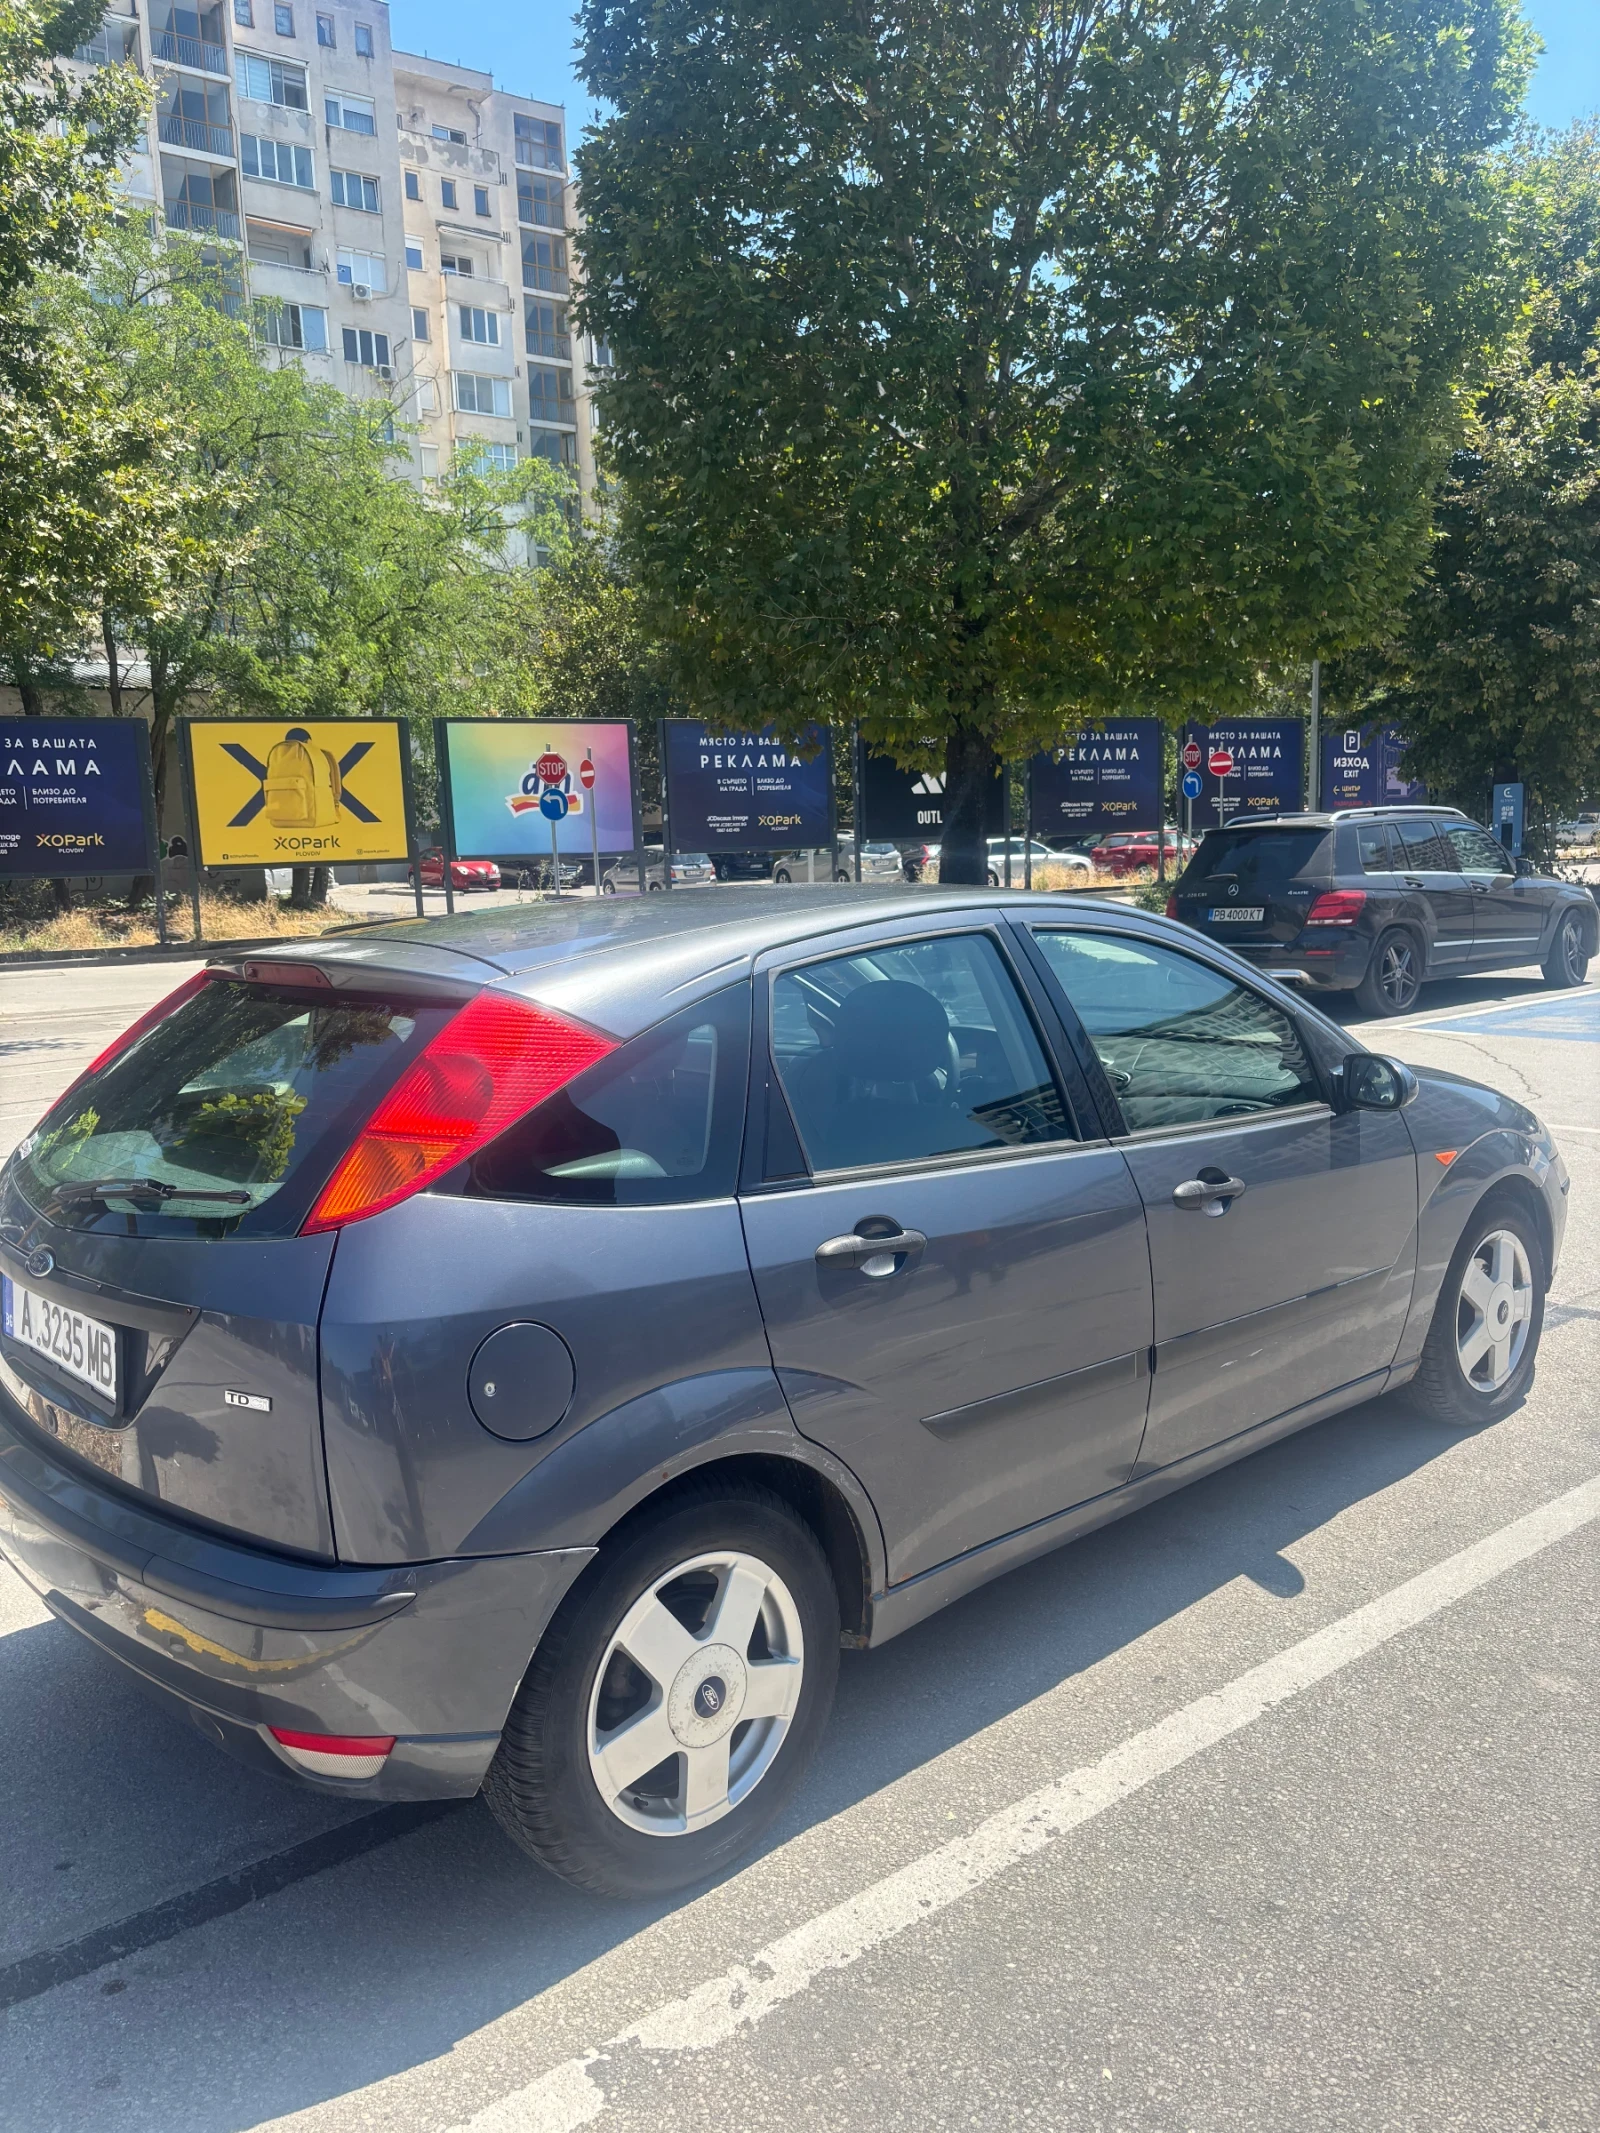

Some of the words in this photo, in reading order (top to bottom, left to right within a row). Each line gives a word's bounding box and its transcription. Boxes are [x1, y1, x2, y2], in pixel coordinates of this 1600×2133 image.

[1090, 732, 1101, 741] ЗА
[1104, 732, 1139, 741] ВАШАТА
[1209, 732, 1235, 740] МЯСТО
[1238, 732, 1247, 740] ЗА
[1250, 731, 1281, 740] ВАШАТА
[4, 738, 24, 749] ЗА
[32, 738, 97, 749] ВАШАТА
[699, 737, 737, 747] МЯСТО
[741, 737, 754, 747] ЗА
[1057, 748, 1140, 761] РЕКЛАМА
[1185, 751, 1199, 762] STOP
[700, 754, 802, 769] РЕКЛАМА
[1333, 757, 1370, 770] ИЗХОД
[539, 762, 565, 776] STOP
[1343, 770, 1359, 778] EXIT
[32, 788, 60, 796] БЛИЗО
[62, 788, 76, 796] ДО
[917, 810, 943, 824] OUTL
[1214, 910, 1225, 920] PB
[1226, 909, 1248, 920] 4000
[1249, 909, 1262, 920] KT
[41, 1300, 84, 1369] 3235
[87, 1323, 113, 1387] MB
